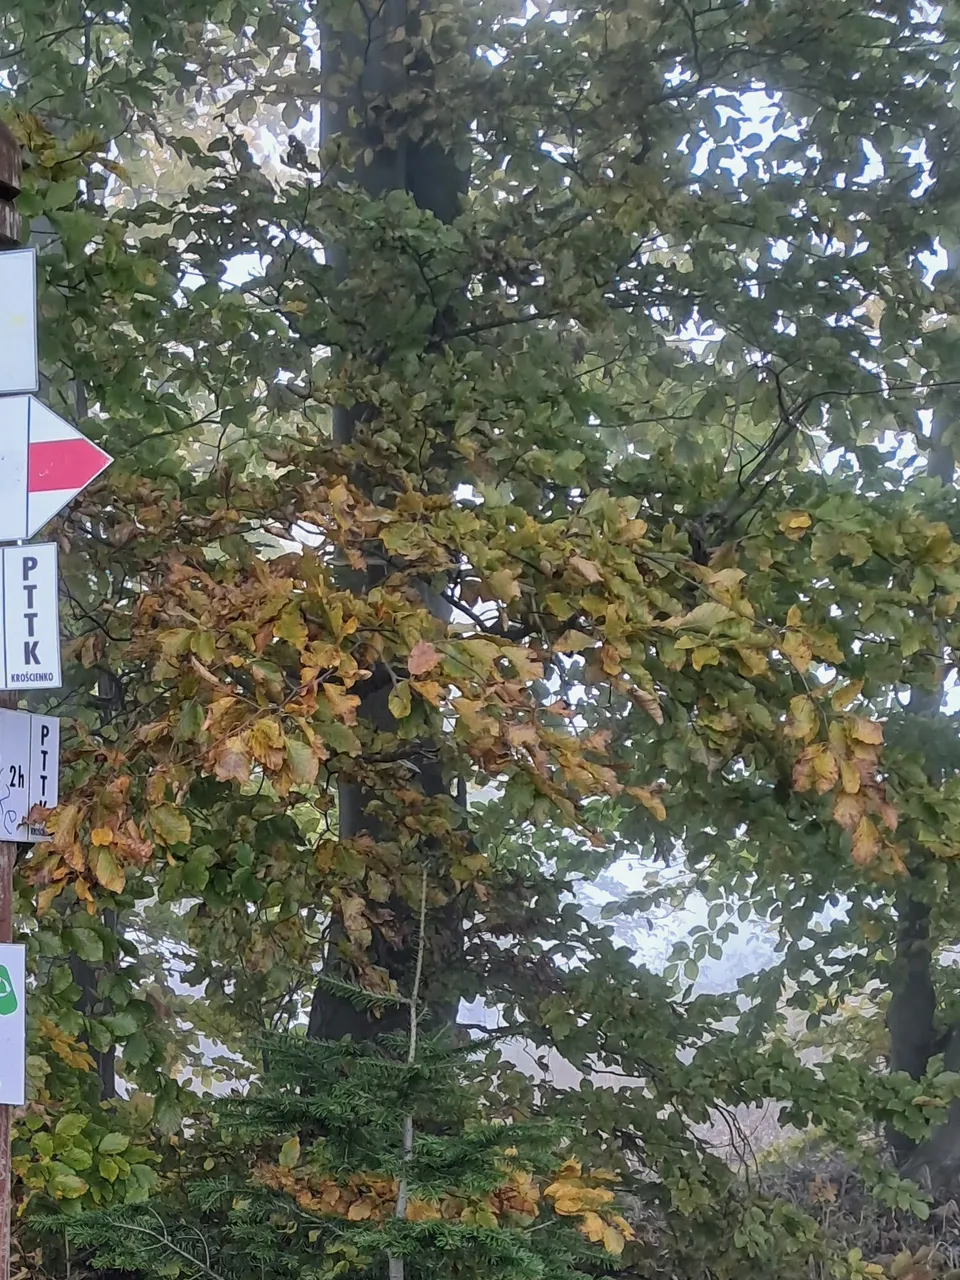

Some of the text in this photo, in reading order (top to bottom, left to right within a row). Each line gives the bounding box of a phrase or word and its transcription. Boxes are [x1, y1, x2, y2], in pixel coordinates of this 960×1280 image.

[22, 556, 42, 665] PTTK
[10, 670, 54, 683] KROŚCIENKO
[9, 764, 25, 789] 2h
